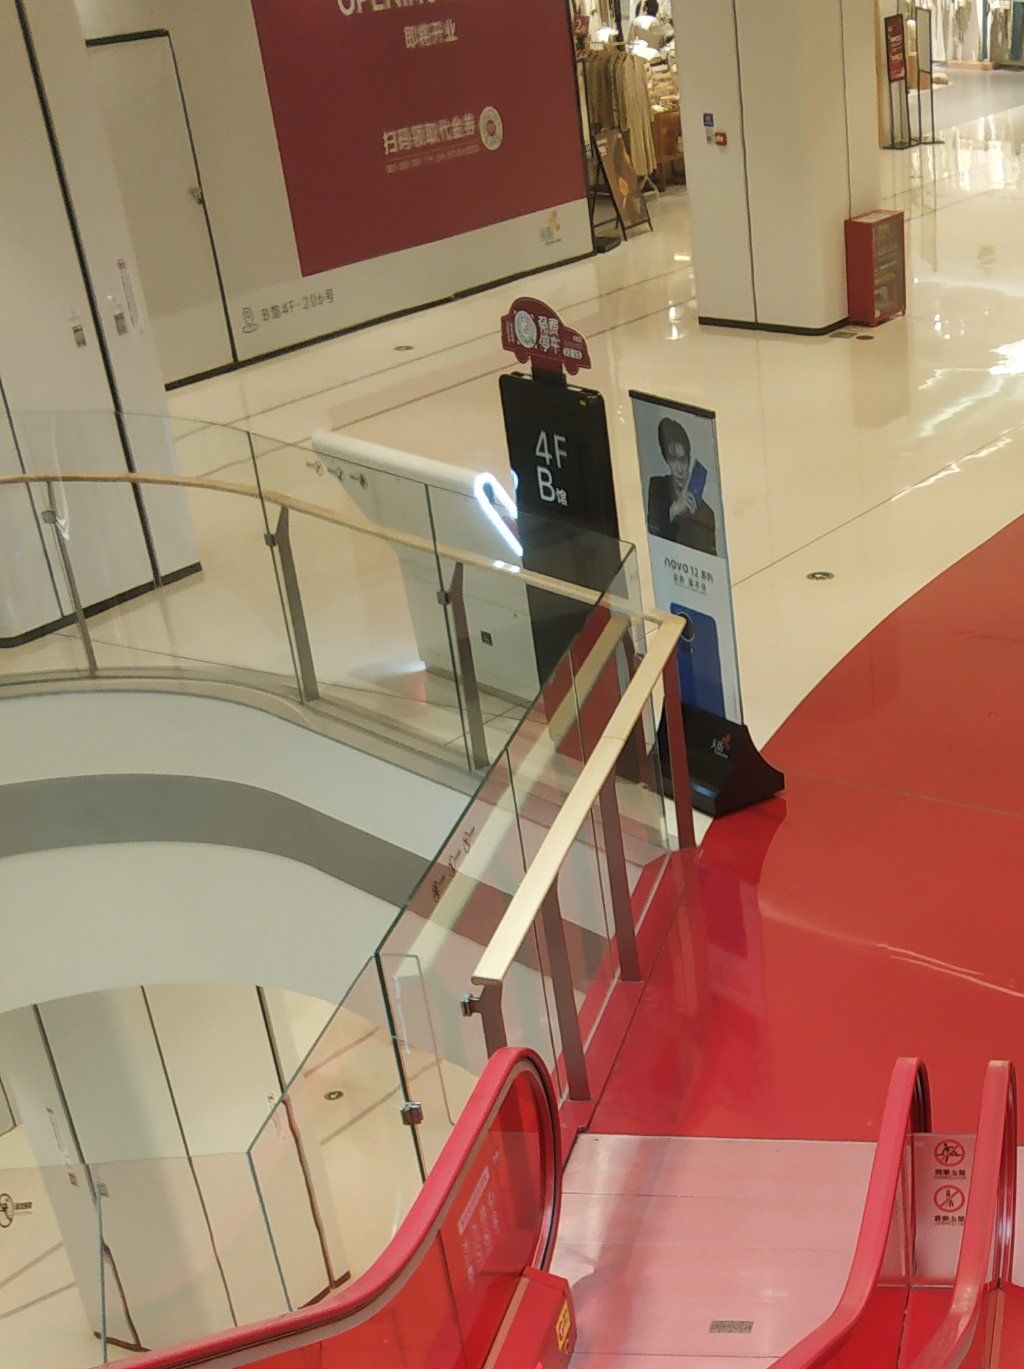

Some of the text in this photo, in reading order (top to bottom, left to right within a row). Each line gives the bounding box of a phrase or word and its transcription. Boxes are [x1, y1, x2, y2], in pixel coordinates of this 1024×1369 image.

[403, 18, 459, 49] 即将开业
[382, 112, 476, 156] 扫码领取代金券
[537, 315, 560, 336] 免费
[539, 334, 561, 355] 停车
[535, 430, 568, 469] 4F
[536, 465, 568, 507] B馆
[663, 556, 689, 574] nova
[690, 565, 699, 578] 12
